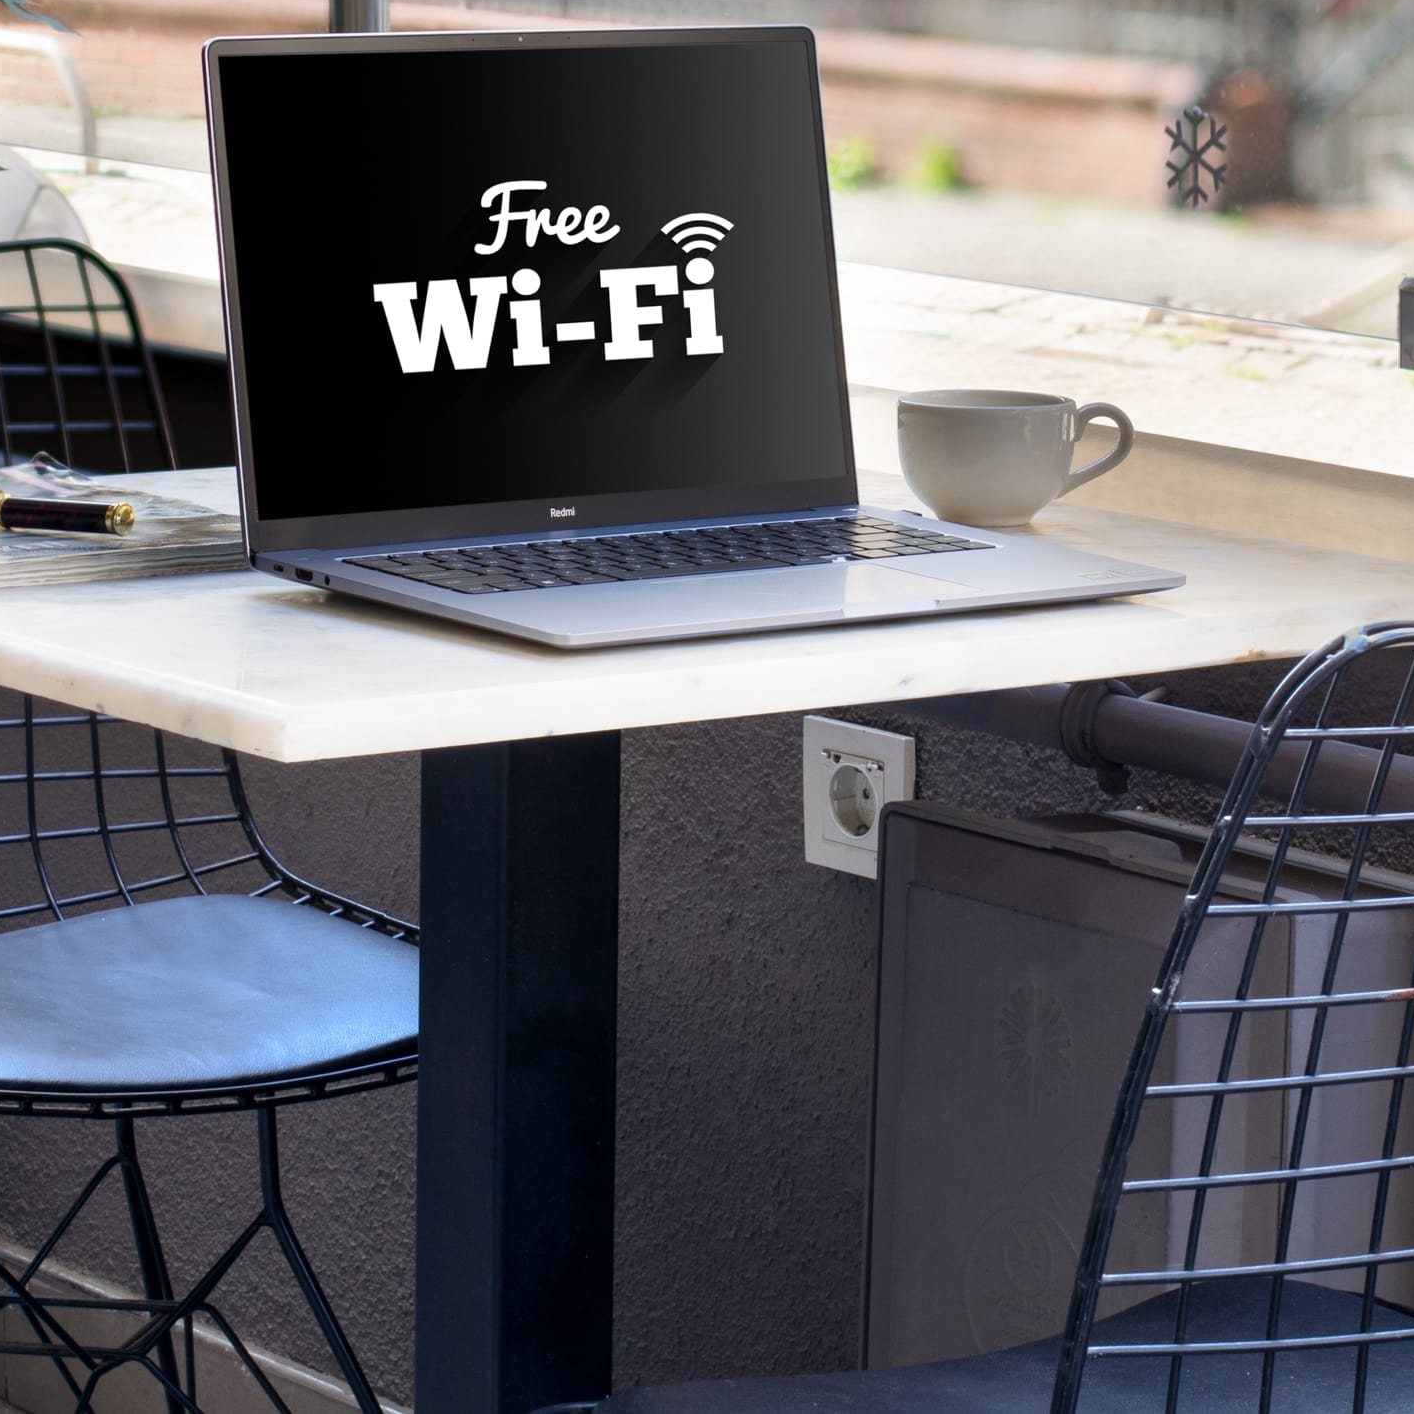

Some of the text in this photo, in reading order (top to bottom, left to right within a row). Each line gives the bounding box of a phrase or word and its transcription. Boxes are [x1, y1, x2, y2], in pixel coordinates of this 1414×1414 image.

[474, 179, 621, 255] Free
[372, 257, 724, 374] Wi-Fi
[550, 507, 575, 518] Redmi
